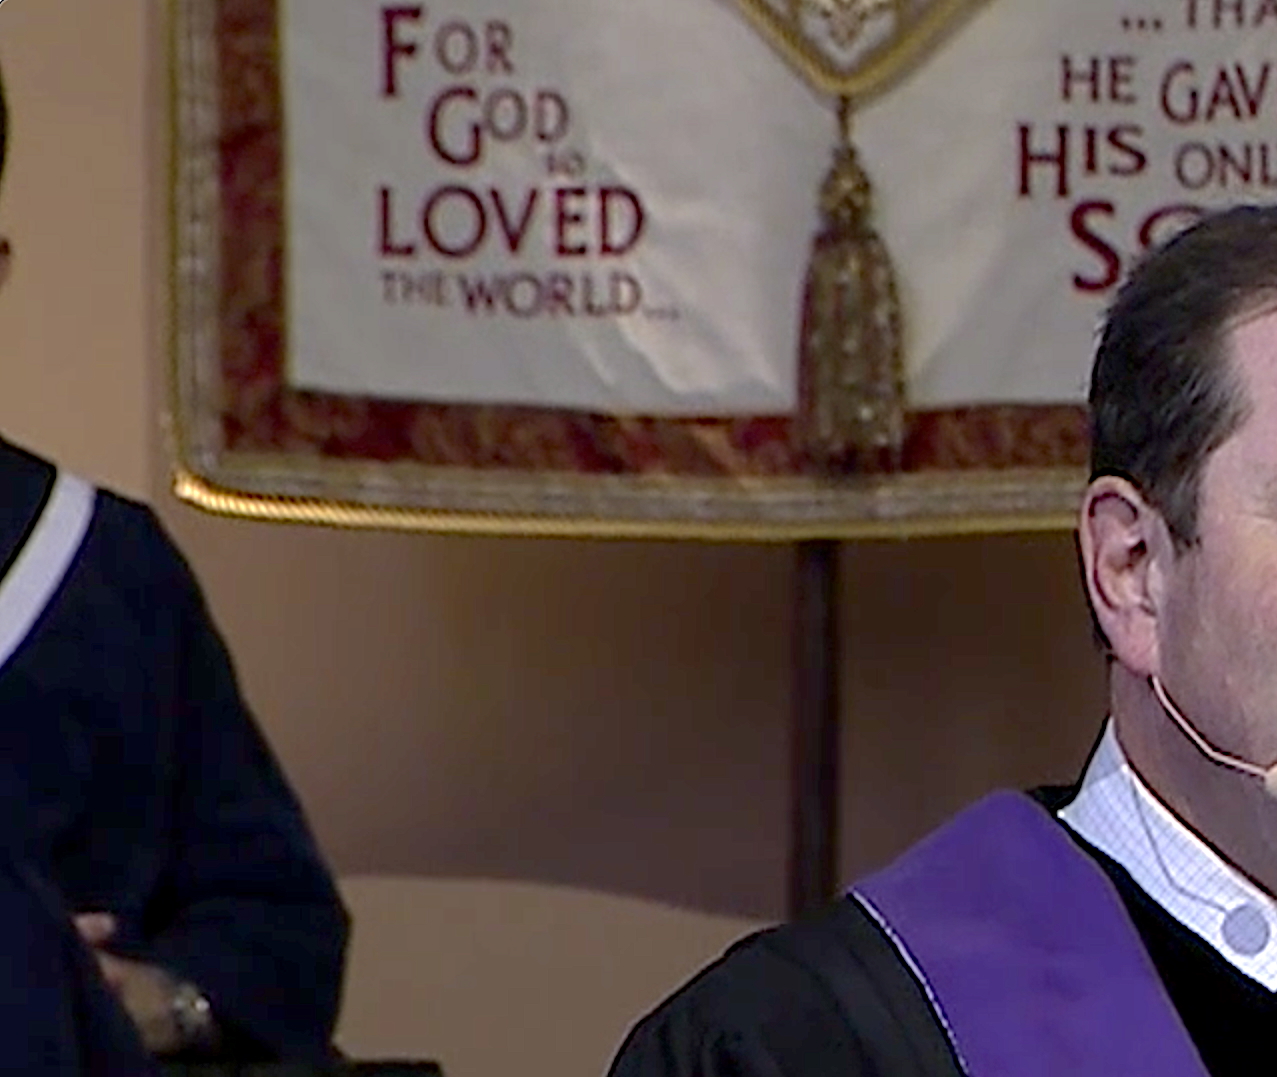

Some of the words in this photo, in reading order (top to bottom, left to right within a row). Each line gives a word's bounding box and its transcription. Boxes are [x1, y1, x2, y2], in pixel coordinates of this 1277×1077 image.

[380, 5, 514, 97] FOR
[1060, 54, 1137, 104] HE
[427, 85, 570, 167] GOD
[1016, 122, 1148, 199] HIS
[379, 184, 646, 259] LOVED
[380, 270, 446, 307] THE
